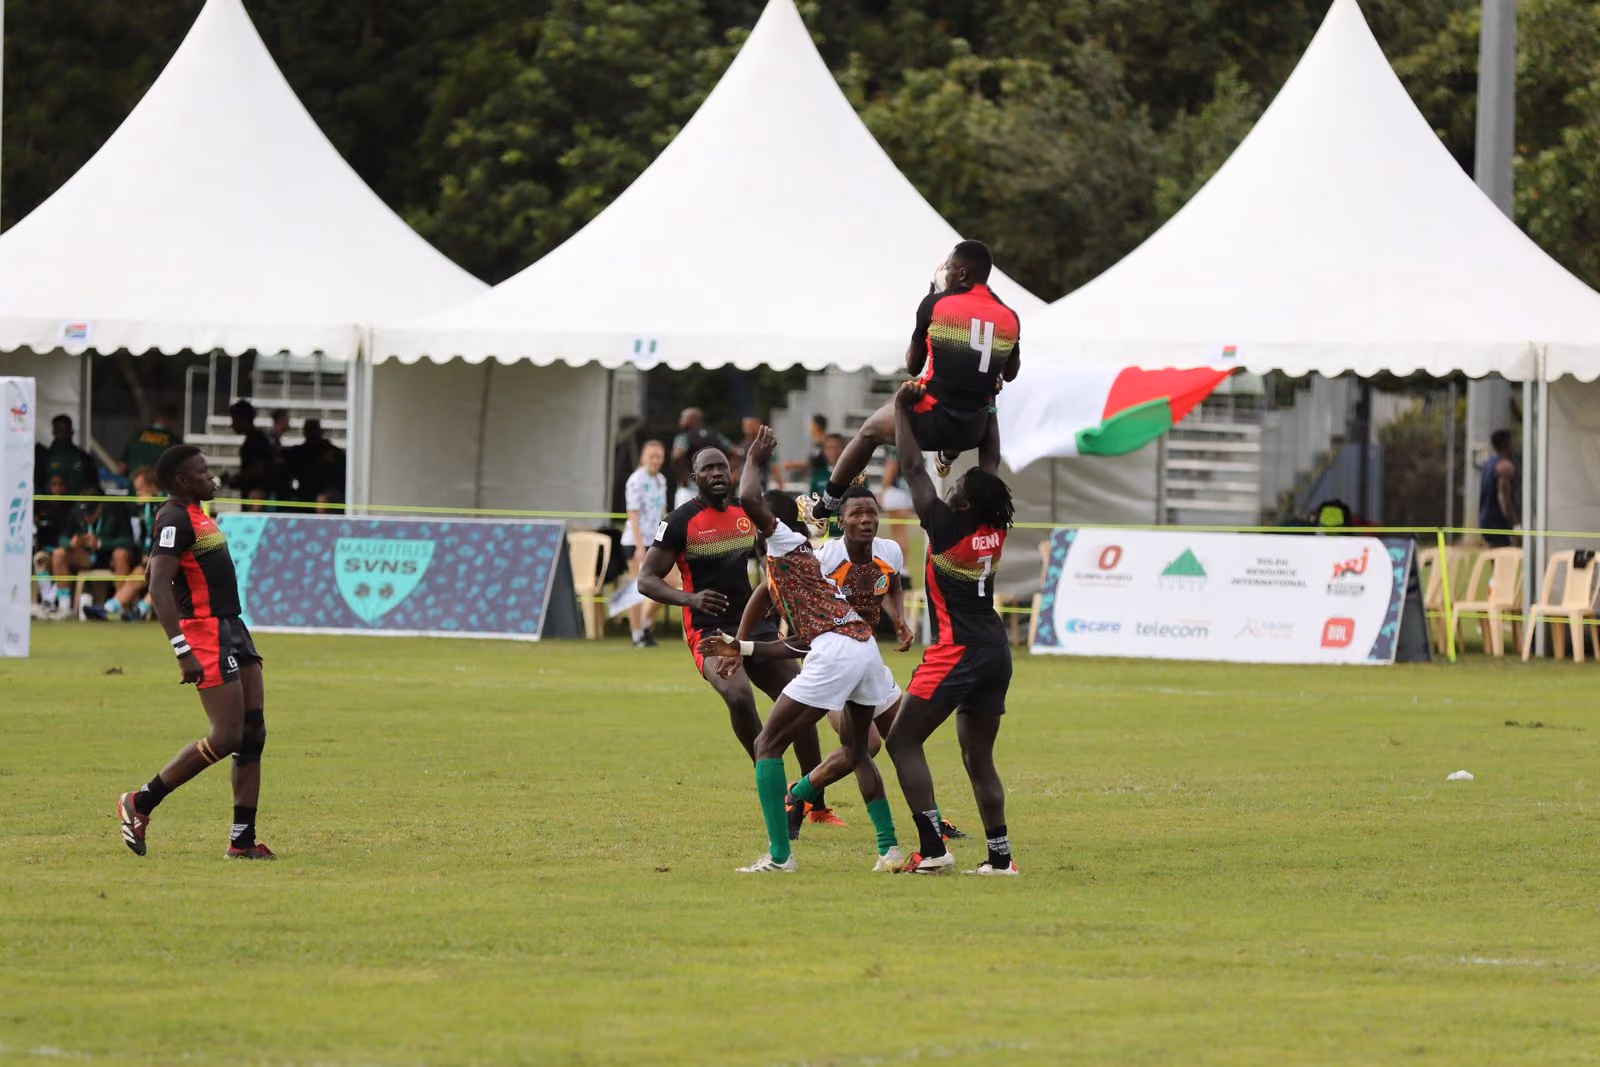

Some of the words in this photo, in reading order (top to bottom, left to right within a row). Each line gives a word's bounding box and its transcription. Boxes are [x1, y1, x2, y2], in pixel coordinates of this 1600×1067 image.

[969, 317, 994, 373] 4
[340, 542, 430, 557] MAURITIUS
[344, 558, 417, 574] SVNS
[977, 554, 993, 597] 7
[1231, 578, 1308, 588] INTERNATIONAL
[1136, 621, 1209, 638] telecom
